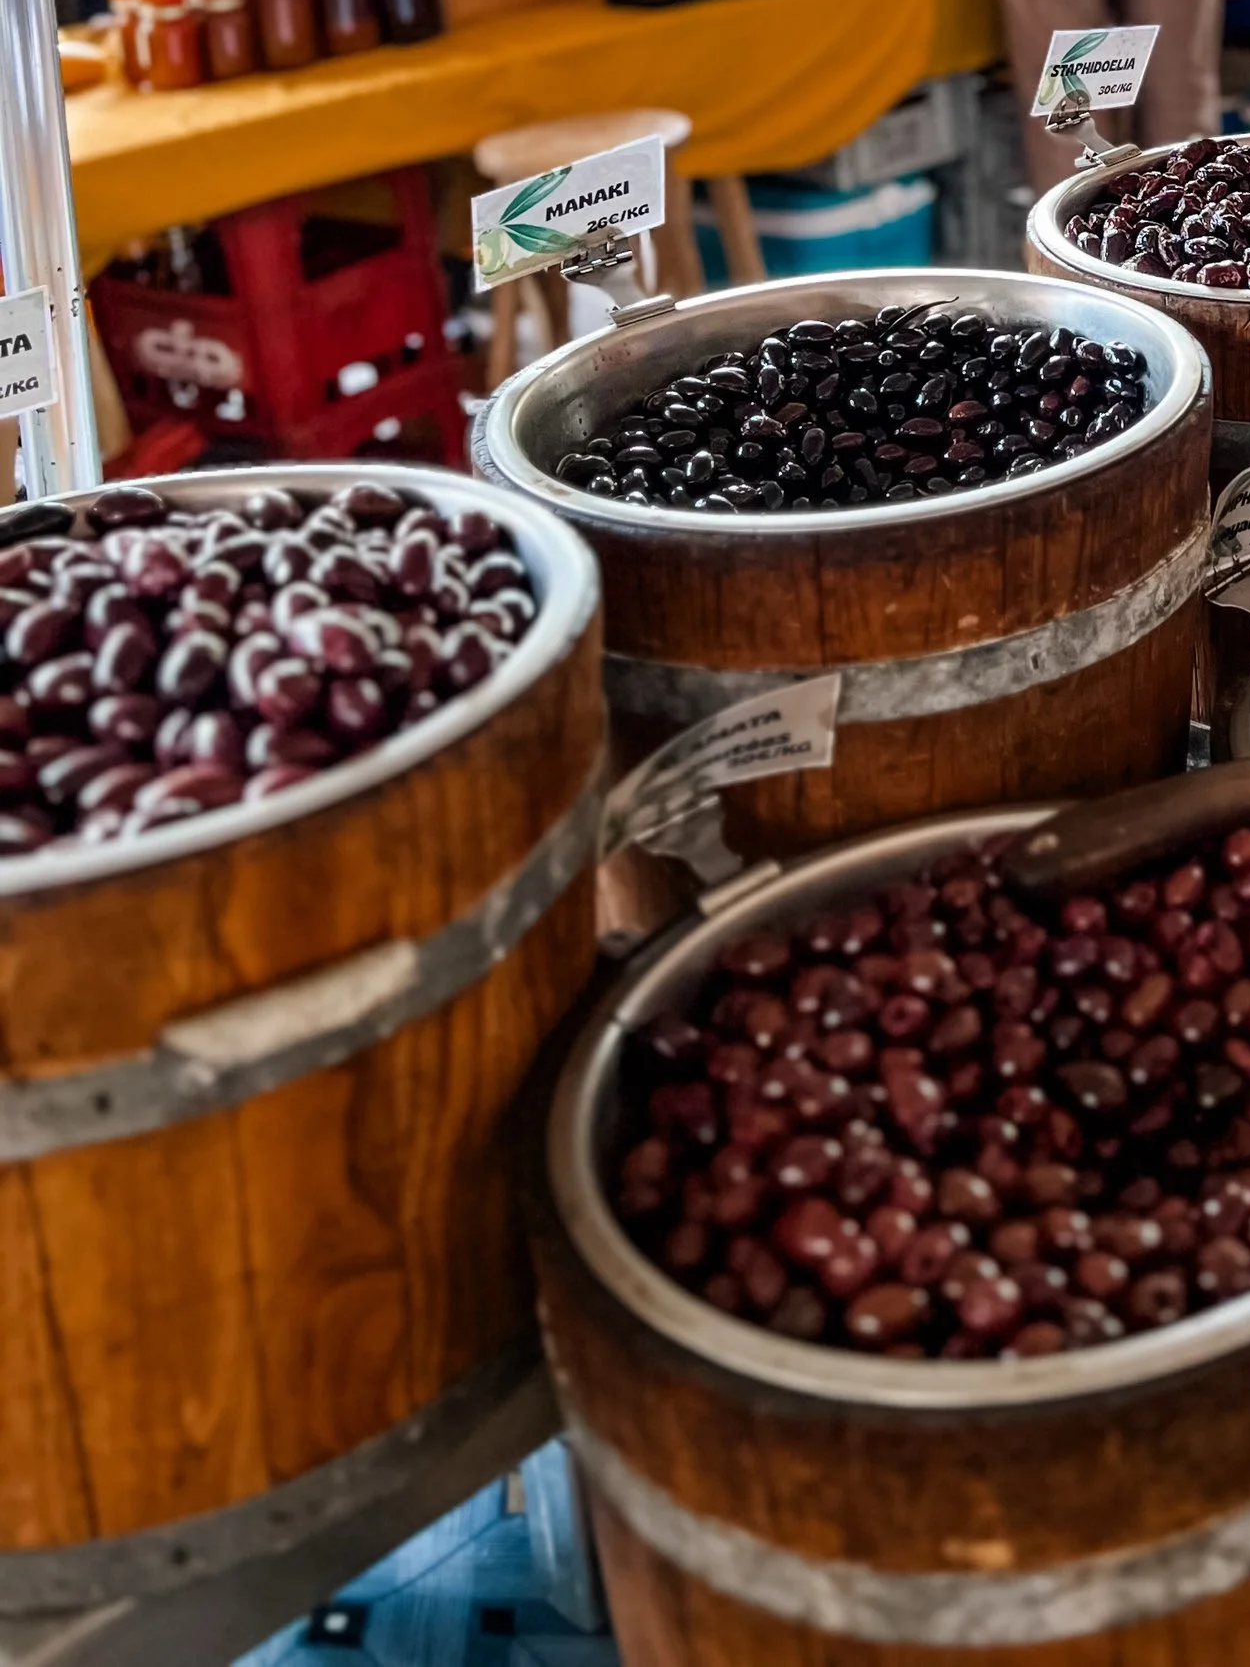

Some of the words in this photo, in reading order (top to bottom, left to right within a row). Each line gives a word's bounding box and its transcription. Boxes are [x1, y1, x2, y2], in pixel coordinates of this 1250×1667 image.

[1050, 57, 1136, 78] STAPHIDOELIA
[1098, 82, 1132, 95] 30€/KG
[545, 180, 630, 222] MANAKI
